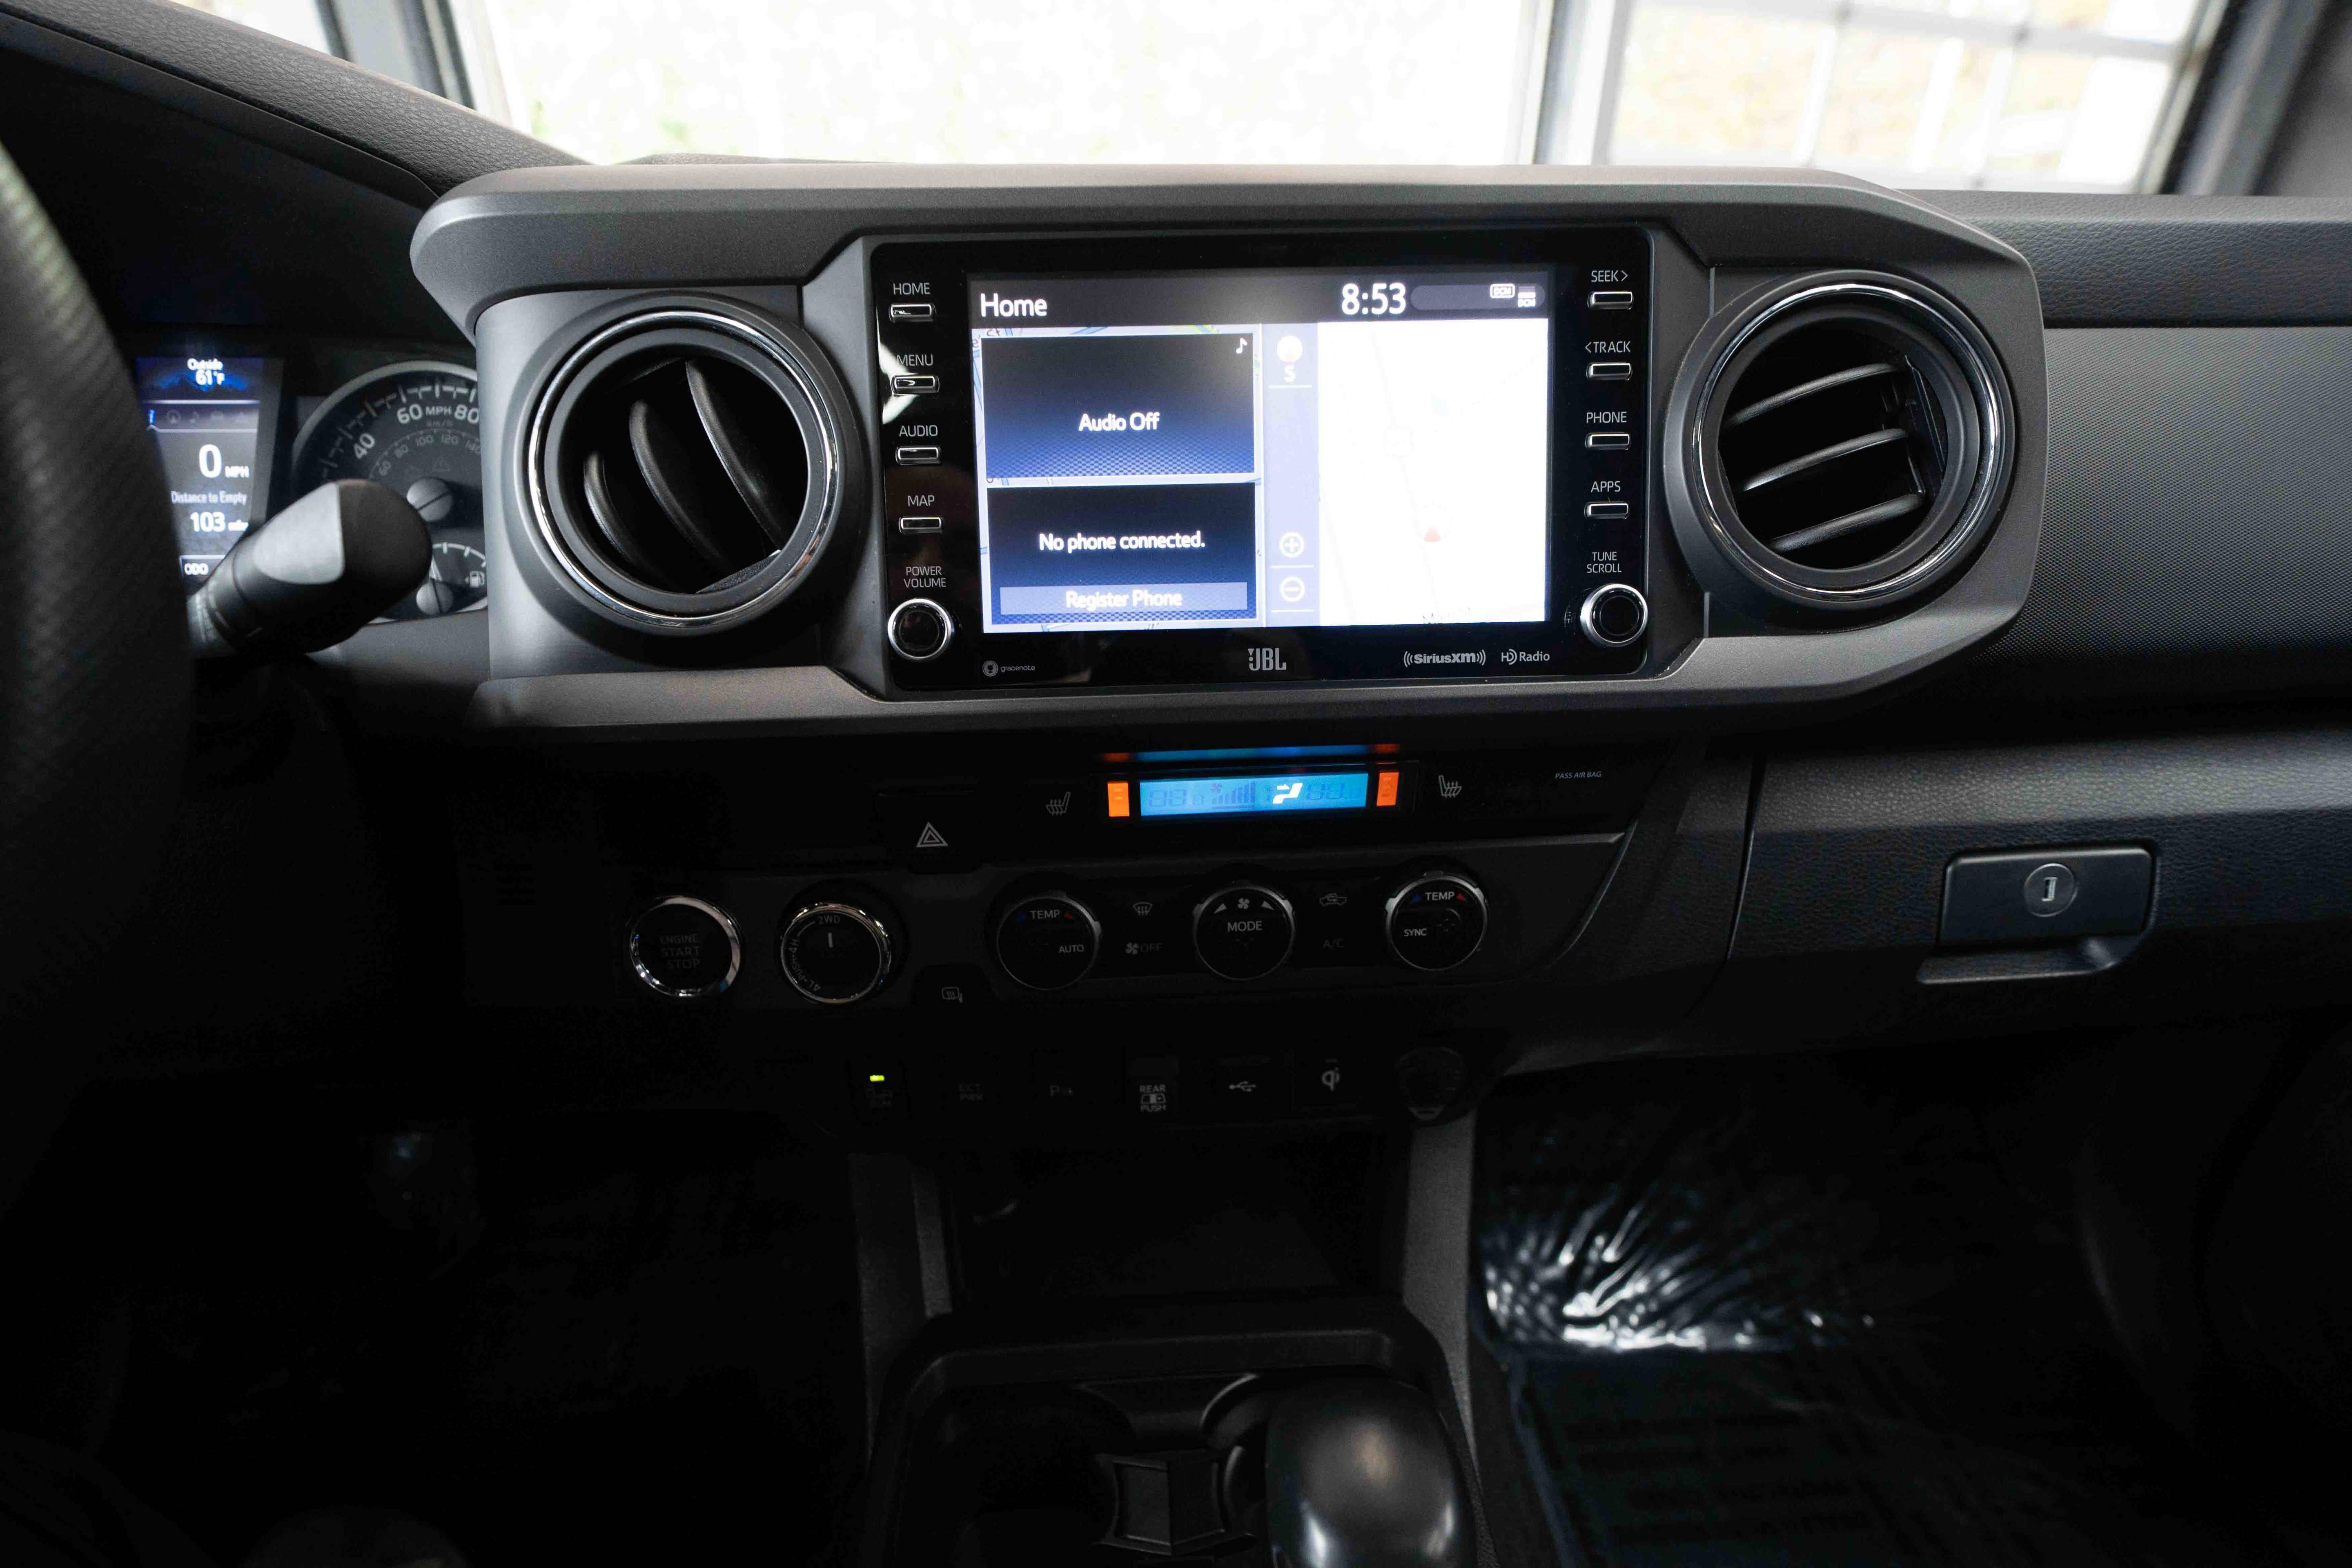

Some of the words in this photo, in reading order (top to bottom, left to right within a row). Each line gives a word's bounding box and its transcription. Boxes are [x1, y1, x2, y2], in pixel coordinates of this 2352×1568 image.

[893, 283, 931, 295] HOME
[980, 292, 1047, 317] Home
[1341, 283, 1406, 314] 8:53
[896, 354, 934, 367] MENU
[397, 403, 423, 424] 60
[425, 406, 452, 416] MPH
[454, 404, 479, 424] 80
[1078, 413, 1126, 432] Audio
[1130, 412, 1160, 431] Off
[1586, 412, 1628, 424] PHONE
[899, 425, 939, 437] AUDIO
[415, 435, 434, 447] 100
[441, 434, 459, 445] 120
[353, 433, 375, 459] 40
[199, 444, 222, 478] 0
[1591, 481, 1621, 493] APPS
[171, 490, 207, 503] Distance
[208, 492, 218, 503] to
[219, 490, 247, 505] Empty
[907, 495, 935, 507] MAP
[190, 511, 225, 532] 103
[1038, 532, 1064, 551] No
[1067, 532, 1116, 554] phone
[1120, 530, 1205, 550] connected.
[1592, 551, 1617, 561] TUNE
[906, 566, 942, 577] POWER
[1586, 563, 1622, 574] SCROLL
[903, 577, 947, 588] VOLUME
[1065, 590, 1129, 611] Register
[1132, 589, 1183, 607] Phone
[1248, 648, 1287, 671] JBL
[1519, 651, 1550, 662] Radio
[1425, 891, 1455, 902] TEMP
[817, 915, 841, 925] 2WD
[1029, 909, 1061, 920] TEMP
[1227, 920, 1263, 933] MODE
[1403, 928, 1428, 937] SYNC
[1058, 944, 1085, 953] AUTO
[1323, 938, 1344, 949] A/C
[661, 946, 701, 957] START
[667, 958, 701, 970] STOP
[1140, 1084, 1166, 1093] REAR
